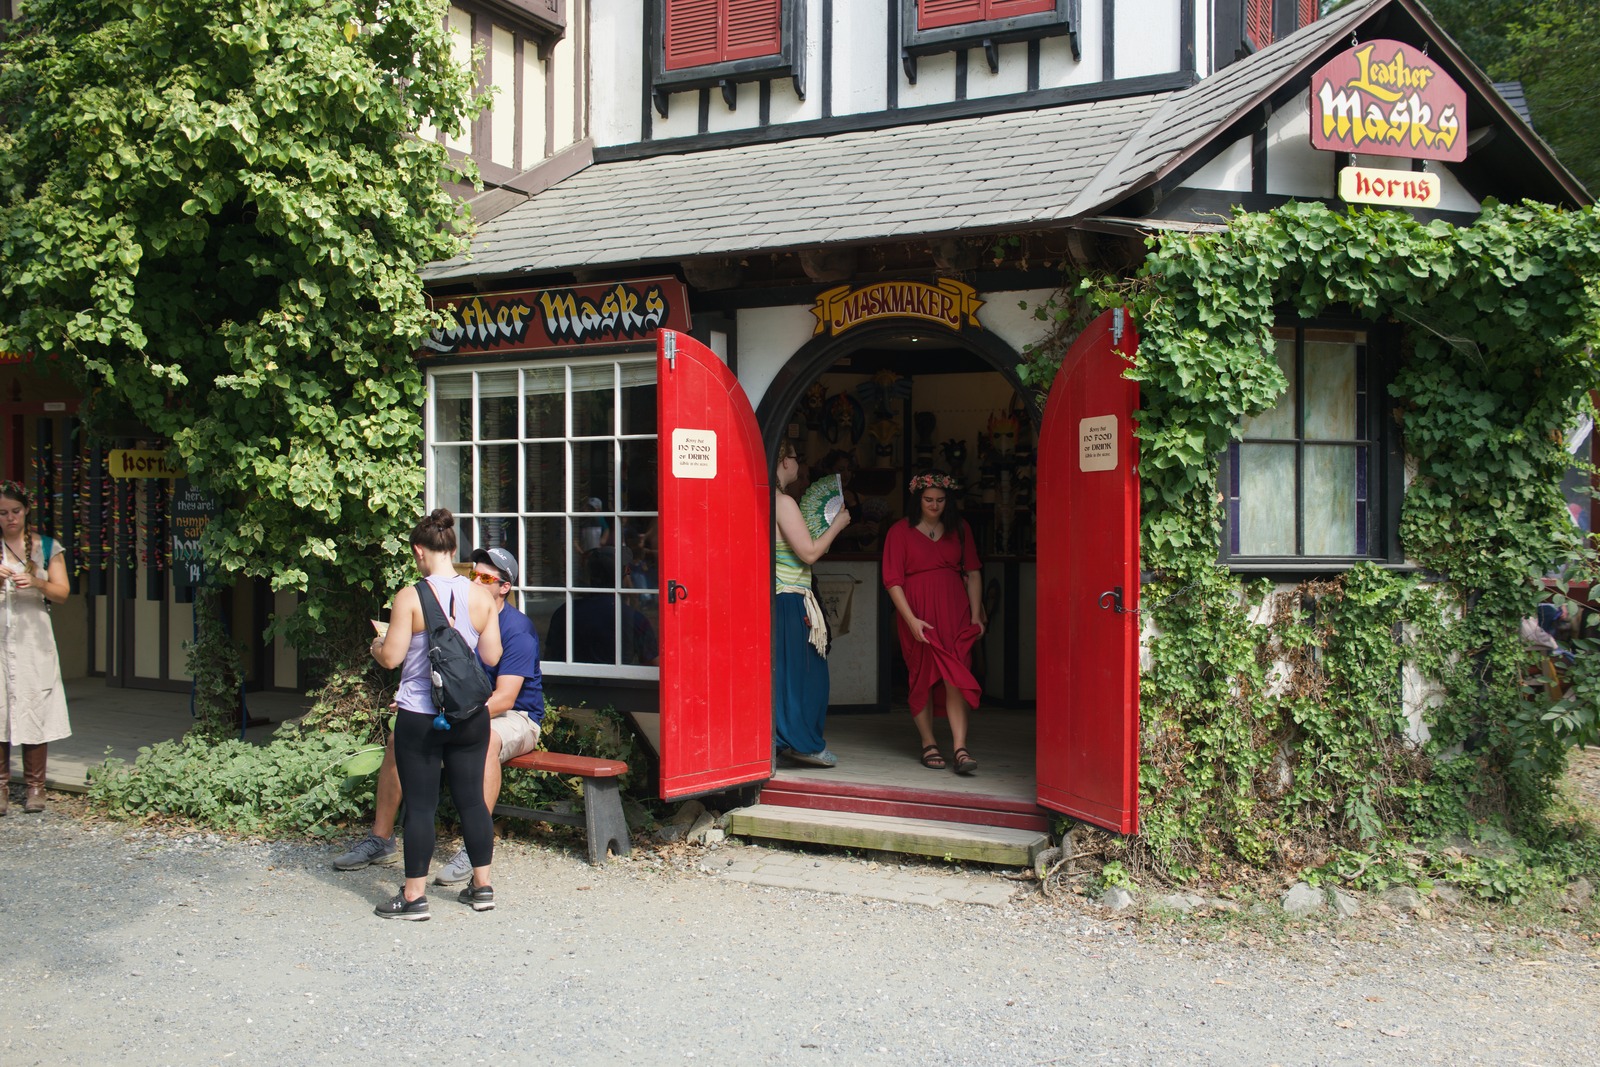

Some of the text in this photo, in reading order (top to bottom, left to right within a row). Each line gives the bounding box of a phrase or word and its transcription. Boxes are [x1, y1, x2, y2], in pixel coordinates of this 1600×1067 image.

[1348, 43, 1434, 102] Leather
[1318, 81, 1460, 150] Masks
[1355, 171, 1431, 202] horns
[540, 284, 665, 338] Masks
[834, 284, 960, 328] MASKMAKER
[690, 444, 711, 452] FOOD
[1091, 442, 1112, 451] DRINK
[1093, 432, 1112, 441] FOOD
[177, 498, 215, 511] they are!
